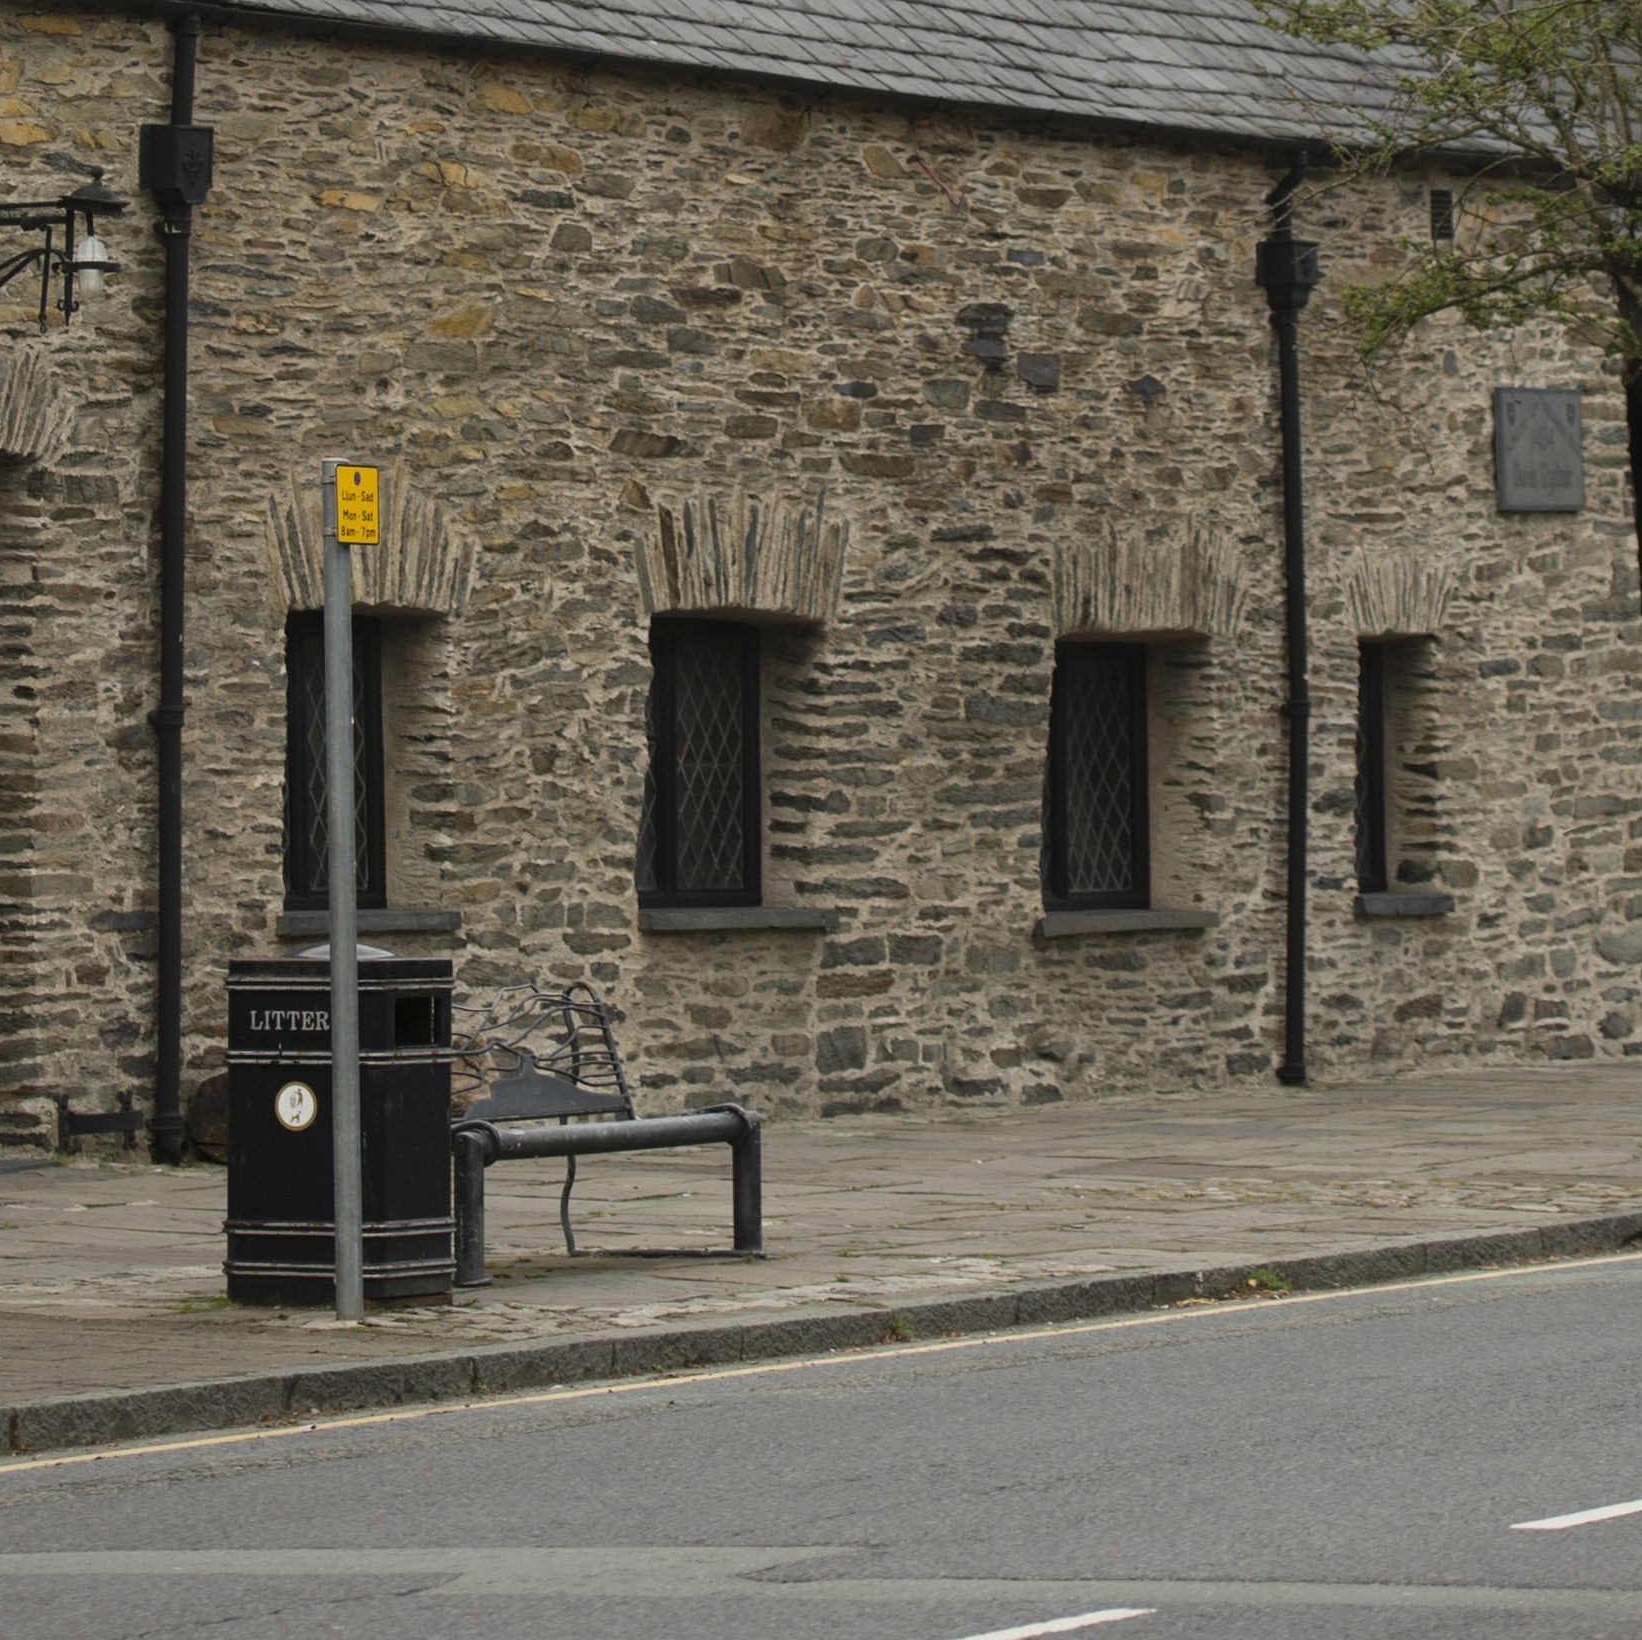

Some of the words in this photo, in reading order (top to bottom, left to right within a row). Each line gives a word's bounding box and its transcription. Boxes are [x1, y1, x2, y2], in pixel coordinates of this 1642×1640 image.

[361, 490, 374, 502] Sad
[342, 509, 357, 521] Mon
[362, 510, 373, 522] Sat
[250, 1010, 330, 1031] LITTER
